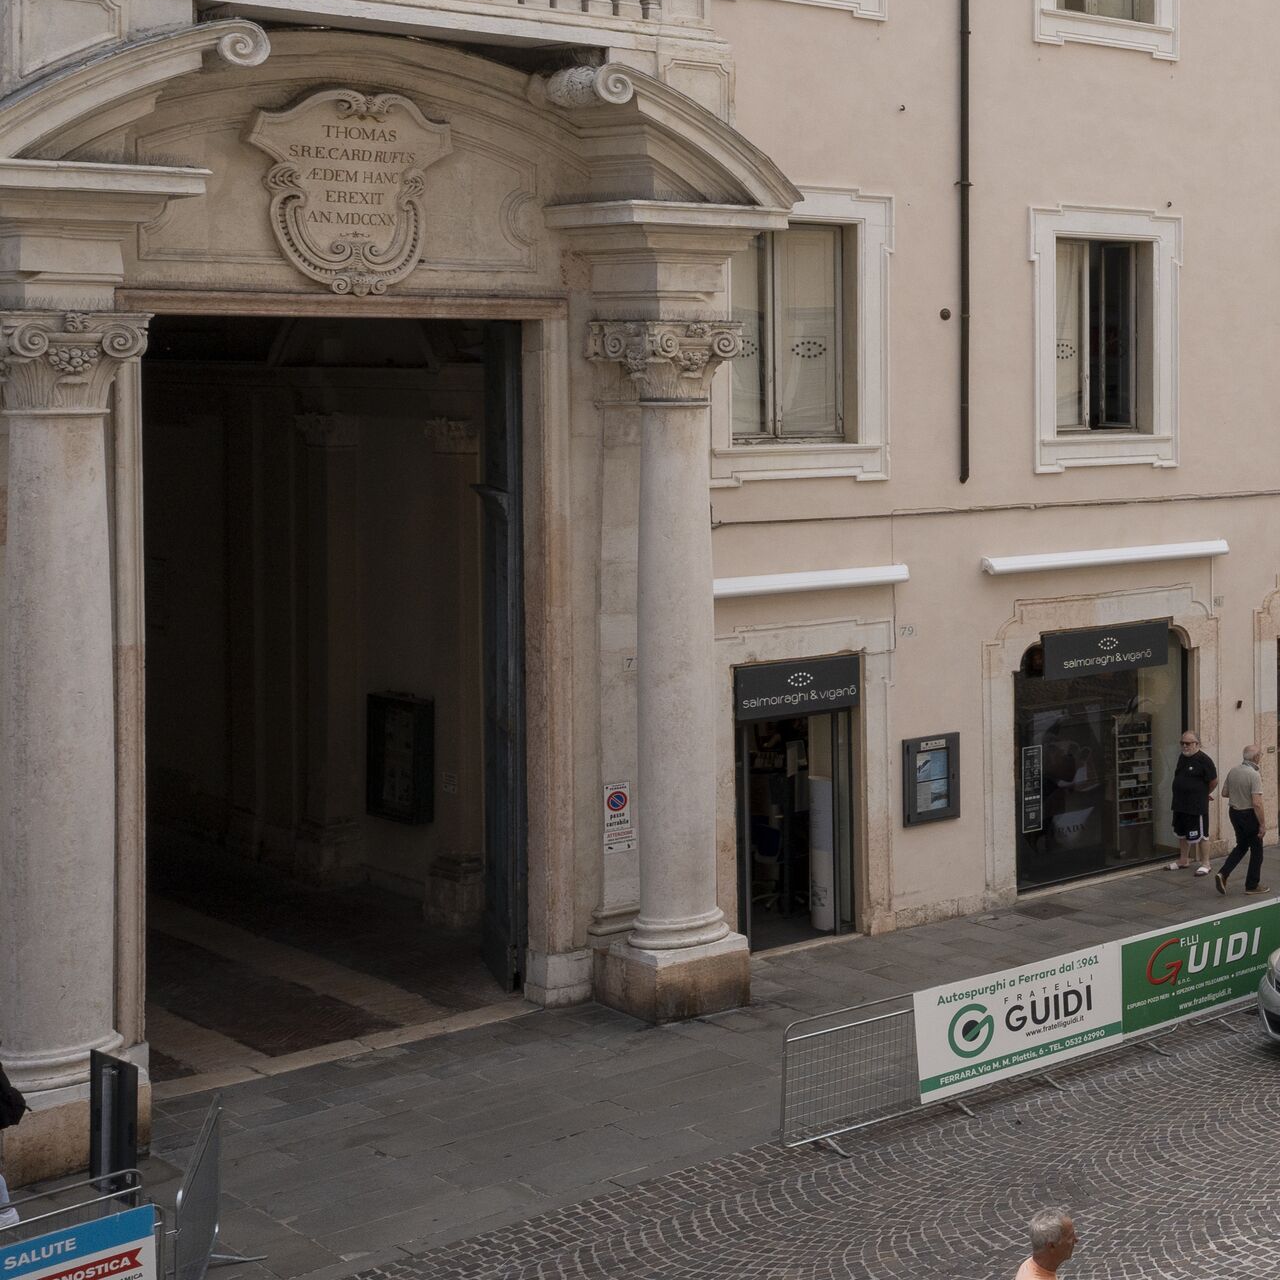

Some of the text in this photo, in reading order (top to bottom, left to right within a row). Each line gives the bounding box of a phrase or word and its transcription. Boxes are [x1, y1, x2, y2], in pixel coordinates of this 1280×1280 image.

[321, 124, 397, 143] THOMAS
[306, 168, 399, 185] ÆDEM HANC
[326, 190, 384, 206] EREXIT
[307, 210, 396, 226] AN. MDCCXX
[900, 627, 914, 636] 79
[1063, 654, 1115, 669] salmoiraghi
[1115, 652, 1123, 662] &
[742, 691, 808, 709] salmoiraghi
[810, 689, 819, 700] &
[1146, 926, 1262, 986] GUIDI
[937, 954, 1099, 1006] Autospurghi a Ferrara dal 1961
[1003, 974, 1094, 1005] FRATELLI
[1004, 985, 1093, 1032] GUIDI
[1178, 987, 1232, 1010] www.fratelliguidi.it
[1025, 1015, 1085, 1038] www.fratelliguidi.it
[992, 1061, 1001, 1070] M.
[1002, 1058, 1011, 1067] M.
[1039, 1047, 1044, 1056] 6
[1049, 1041, 1064, 1053] TEL.
[1064, 1036, 1083, 1048] 0532
[1083, 1029, 1106, 1044] 62990
[4, 1237, 77, 1270] SALUTE
